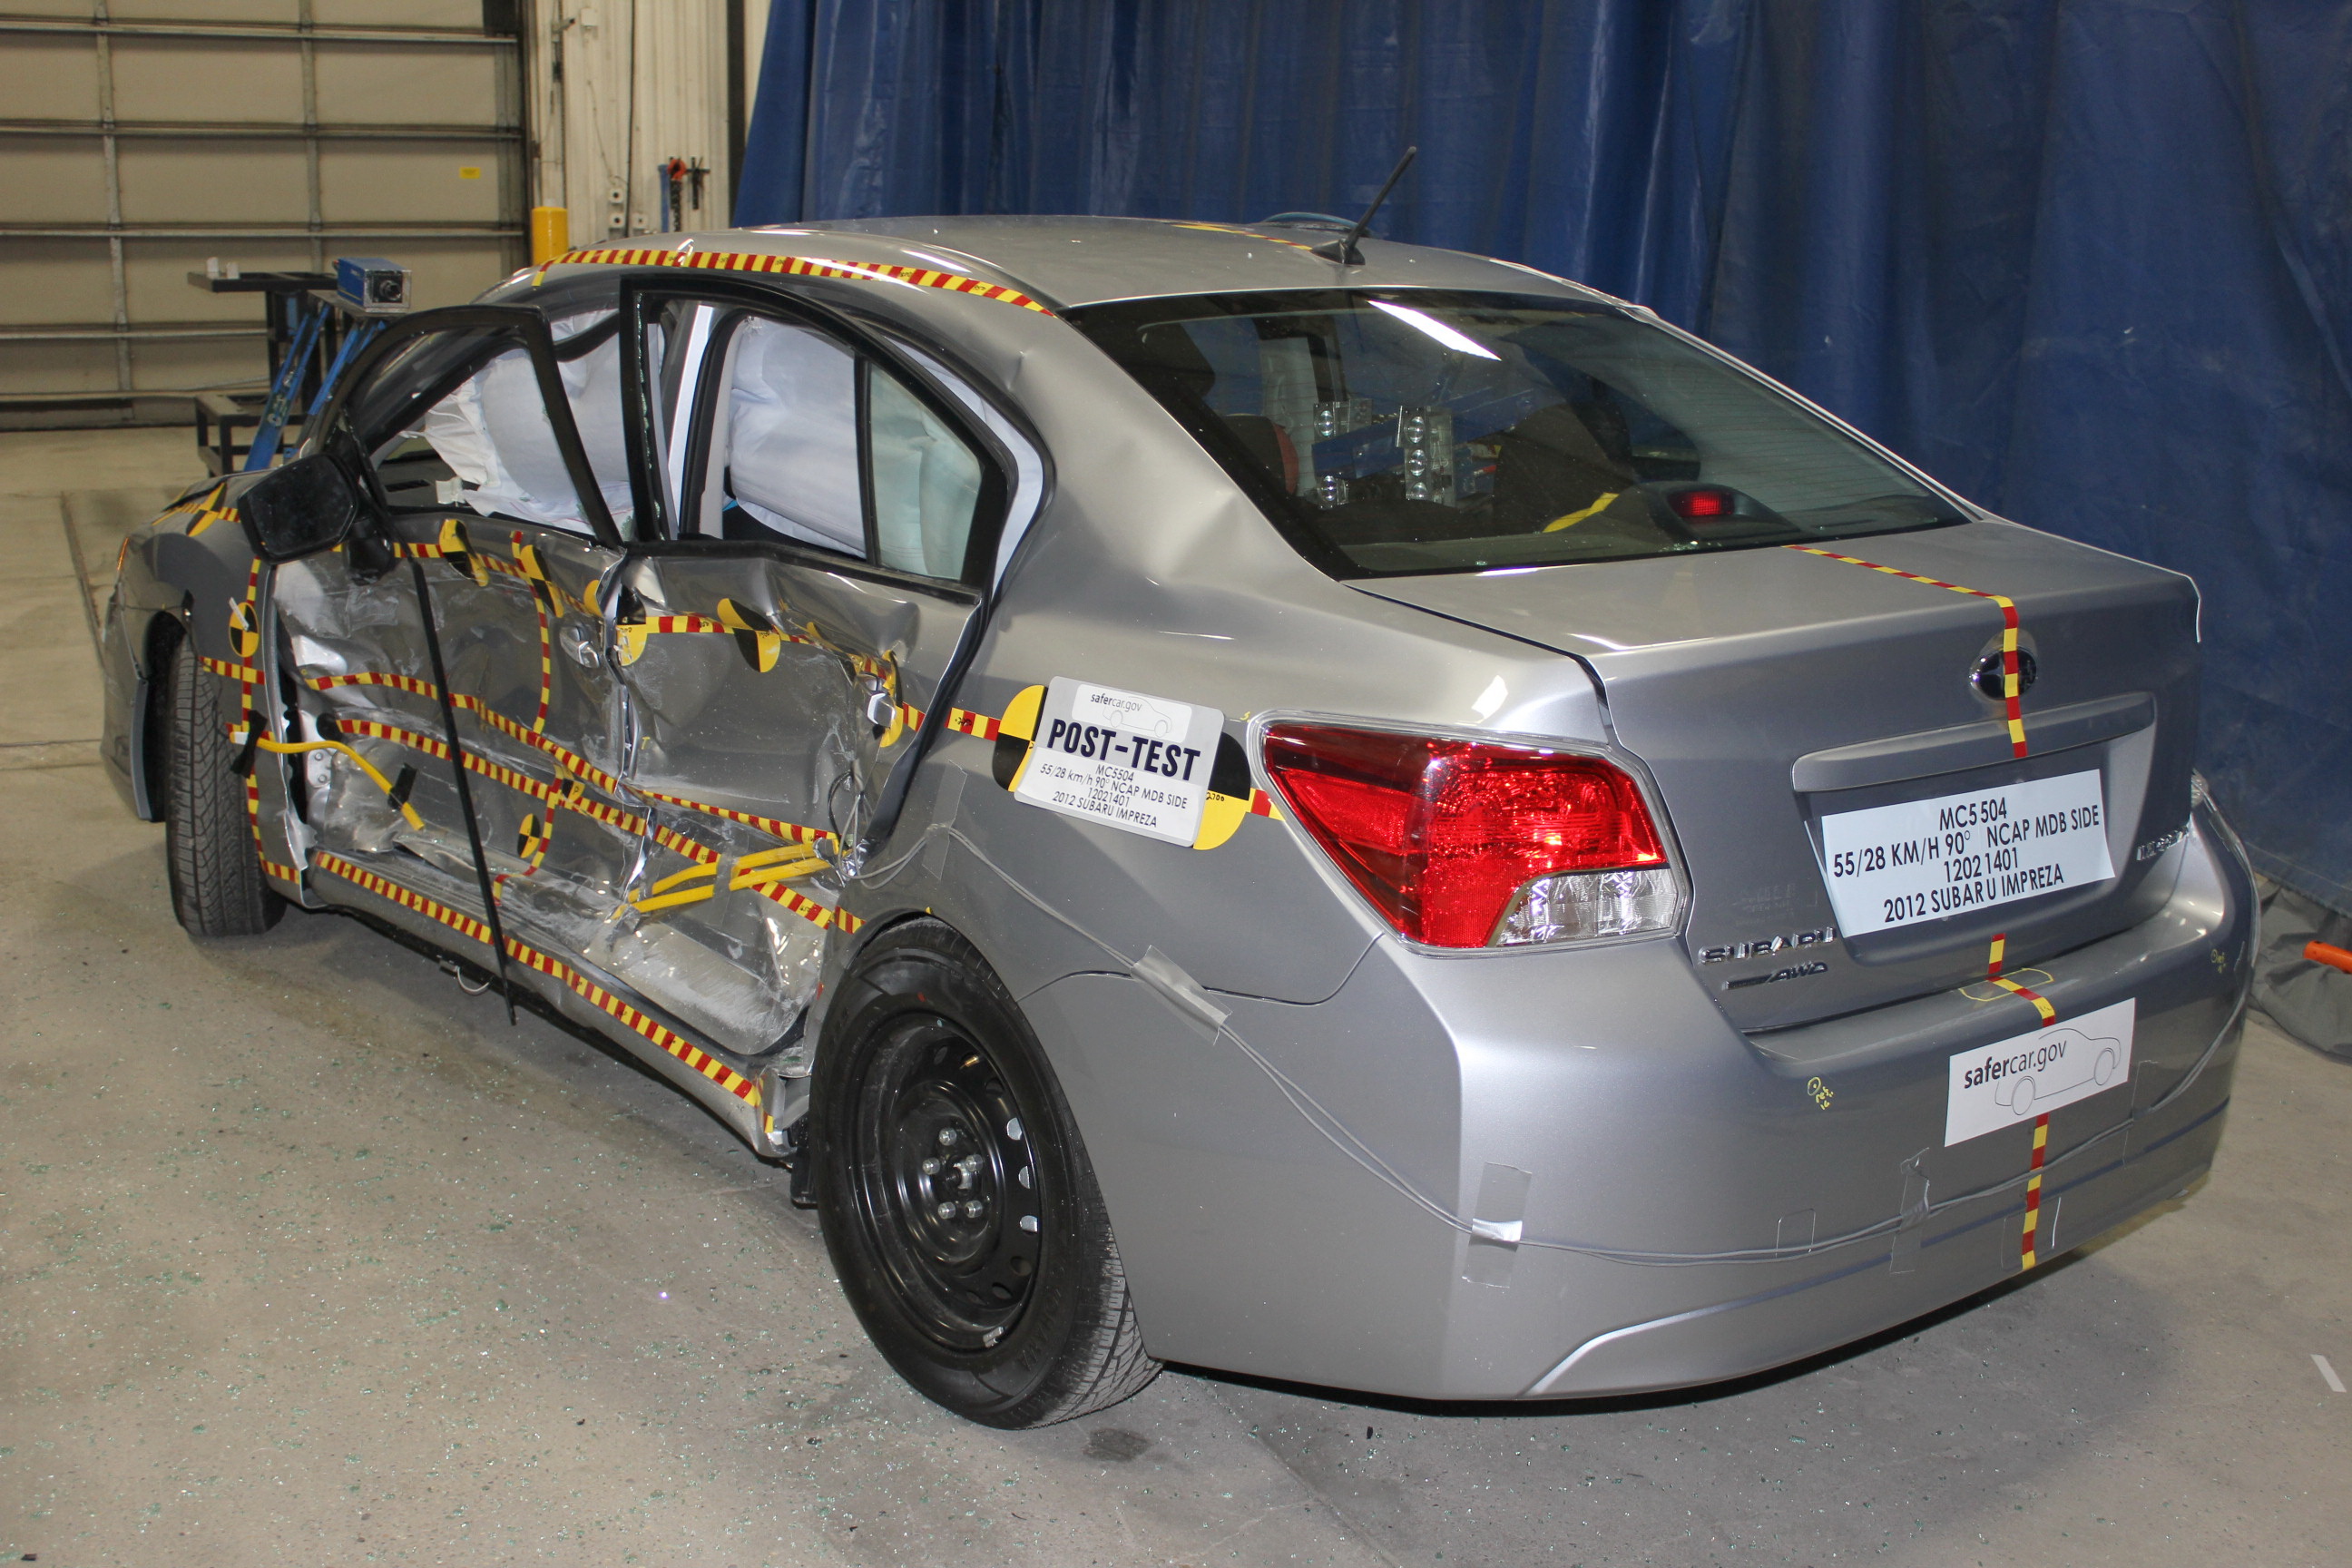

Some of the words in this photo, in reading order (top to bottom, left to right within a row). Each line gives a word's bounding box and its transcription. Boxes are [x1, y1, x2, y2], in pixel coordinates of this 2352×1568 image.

[1090, 692, 1142, 712] safercar.gov
[1046, 718, 1200, 780] POST-TEST
[1040, 763, 1066, 779] 55/28
[1067, 769, 1093, 786] km/h
[1111, 780, 1140, 799] NCAP
[1142, 789, 1164, 804] MDB
[1166, 794, 1188, 809] SIDE
[1095, 764, 1134, 782] MC5504
[1052, 790, 1076, 807] 2012
[1077, 797, 1114, 817] SUBARU
[1115, 806, 1158, 828] IMPREZA
[1088, 788, 1130, 807] 12021401
[1939, 797, 2007, 831] MC5504
[1833, 846, 1885, 877] 55/28
[1891, 837, 1940, 867] KM/H
[1945, 829, 1971, 857] 90°
[1986, 817, 2030, 848] NCAP
[2035, 809, 2067, 838] MDB
[2071, 804, 2100, 829] SIDE
[1944, 848, 2019, 883] 12021401
[1884, 892, 1926, 923] 2012
[1930, 877, 1996, 913] SUBARU
[2001, 863, 2064, 897] IMPREZA
[1699, 926, 1837, 965] SUBARU
[1964, 1040, 2067, 1089] safercar.gov
